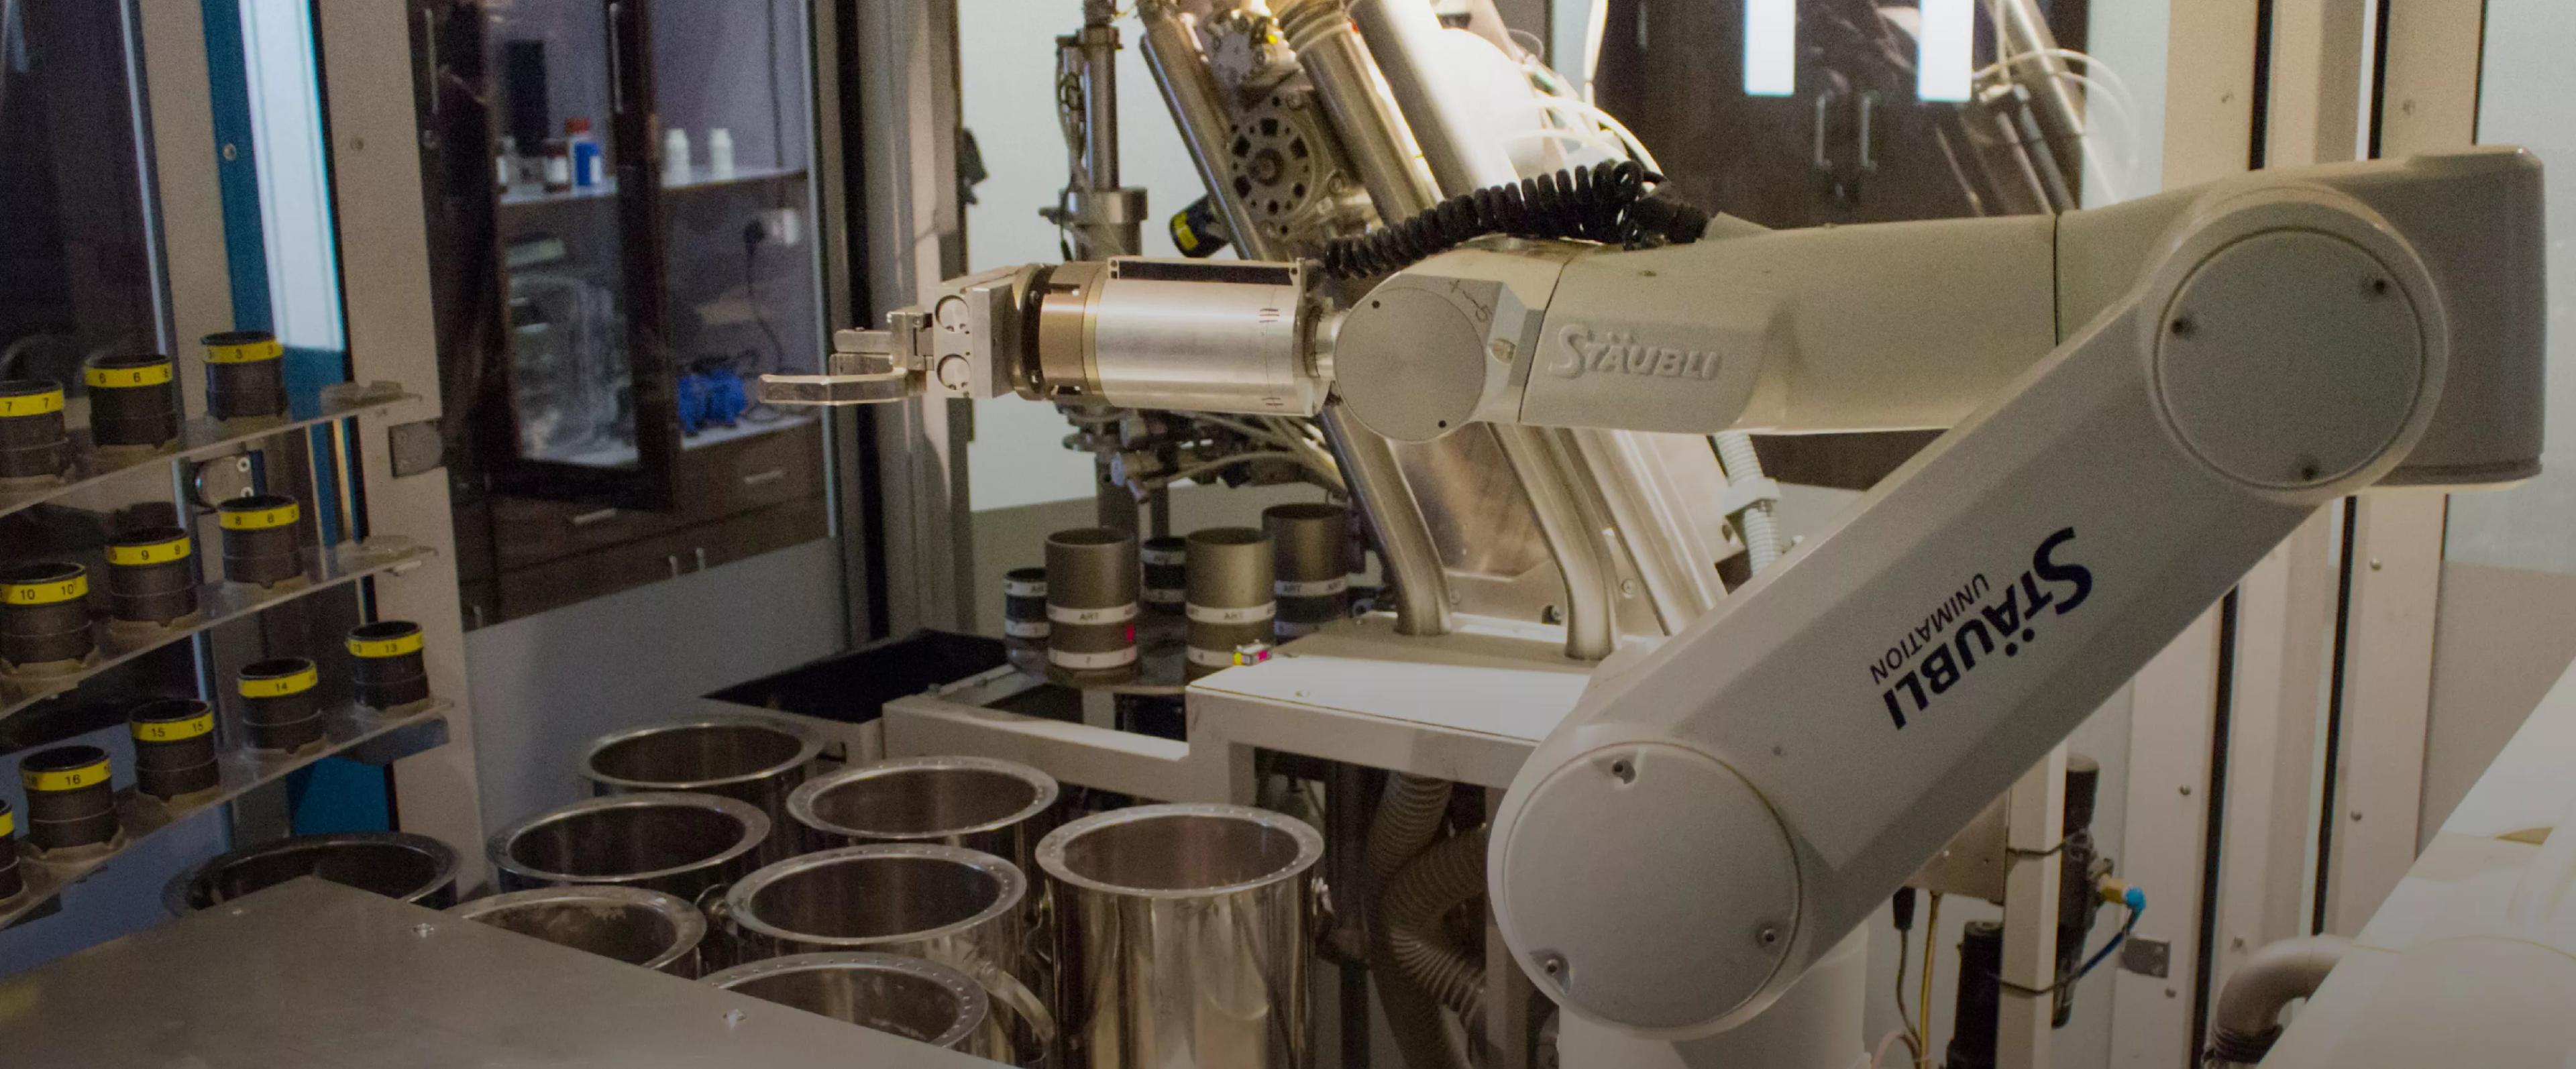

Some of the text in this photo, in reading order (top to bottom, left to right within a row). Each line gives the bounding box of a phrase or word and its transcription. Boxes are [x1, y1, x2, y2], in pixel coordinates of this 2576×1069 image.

[1548, 324, 1722, 381] STÄUBLI
[99, 372, 106, 384] 6
[133, 372, 141, 383] 6
[5, 397, 50, 412] 7 7
[141, 549, 150, 561] 9
[19, 583, 75, 600] 10 10
[1079, 612, 1100, 622] ART
[1869, 573, 1990, 685] UNIMATION
[1882, 526, 2092, 730] STÄUBLI
[275, 681, 288, 693] 14
[150, 722, 204, 738] 15 15
[64, 774, 81, 785] 16
